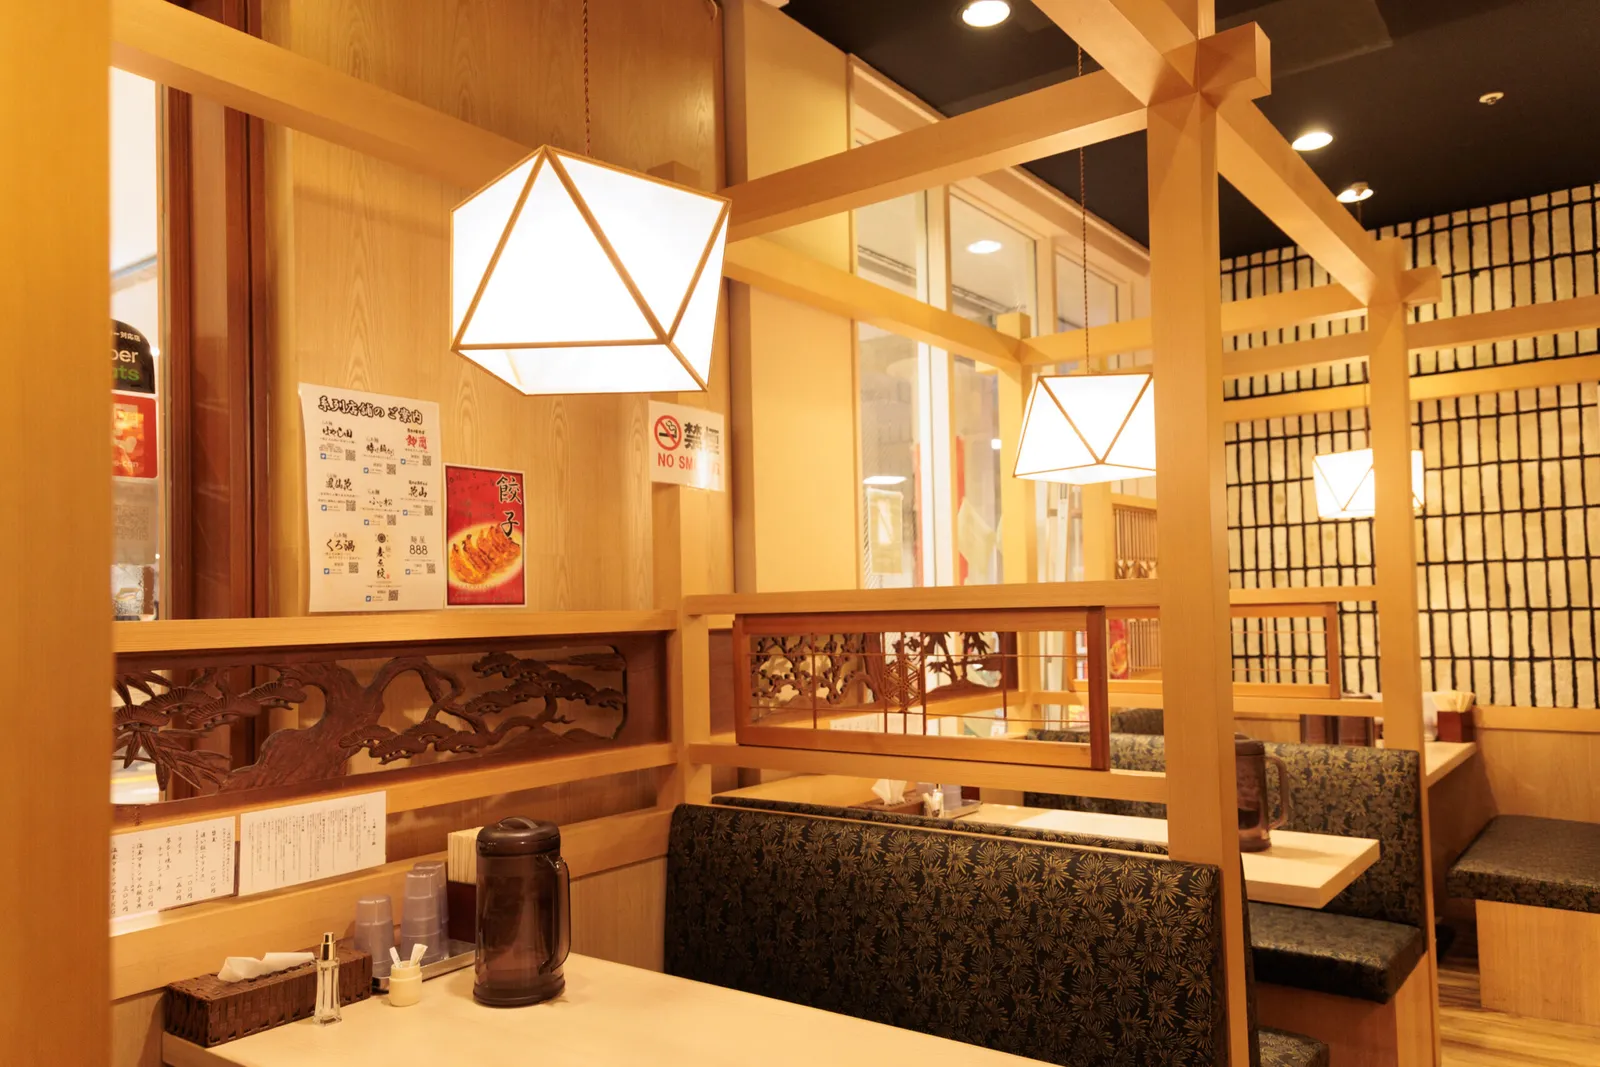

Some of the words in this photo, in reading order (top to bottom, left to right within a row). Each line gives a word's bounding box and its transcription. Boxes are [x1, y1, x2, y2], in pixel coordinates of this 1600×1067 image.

[112, 349, 139, 364] er
[113, 364, 140, 381] ts
[318, 395, 423, 425] 系列店舗のご案内
[657, 452, 674, 467] NO
[496, 475, 521, 538] 餃子
[409, 544, 428, 555] 888
